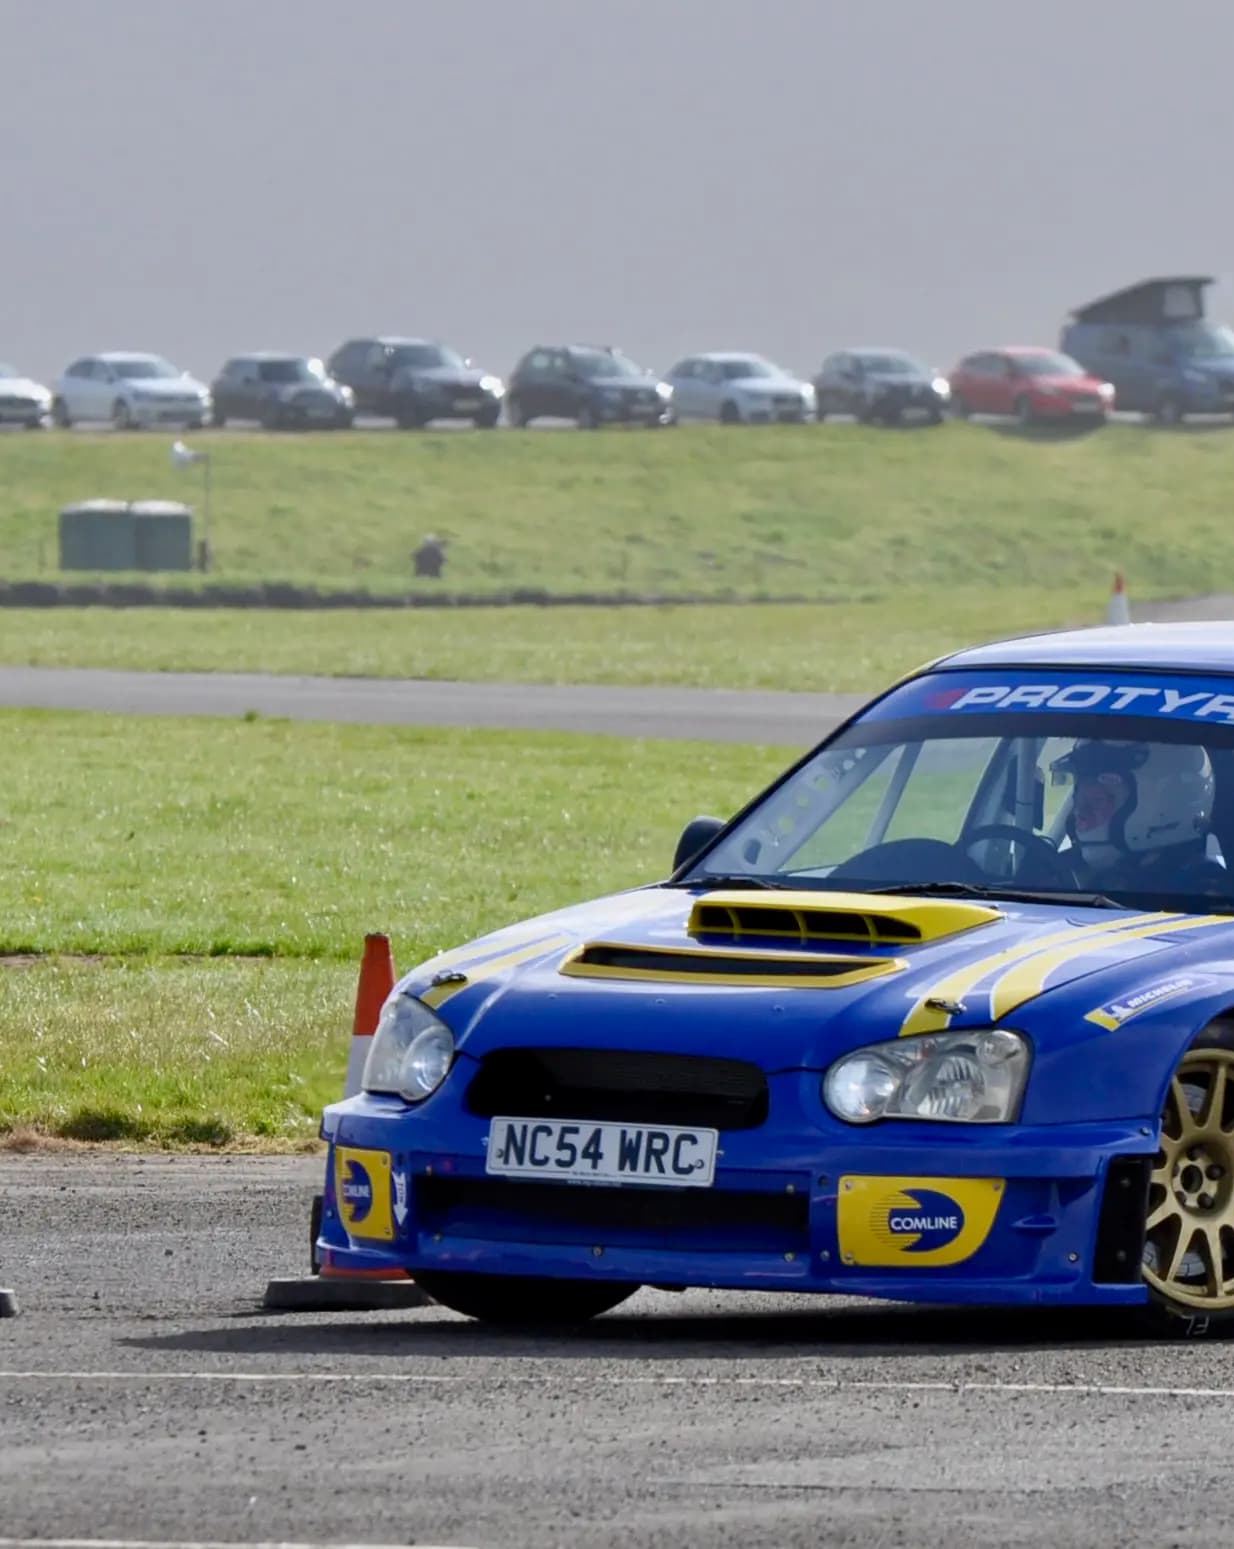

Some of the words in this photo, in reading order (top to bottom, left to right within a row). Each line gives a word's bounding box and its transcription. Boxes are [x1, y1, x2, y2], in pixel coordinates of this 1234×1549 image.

[502, 1123, 604, 1170] NC54
[617, 1129, 698, 1175] WRC
[890, 1216, 958, 1230] COMLINE
